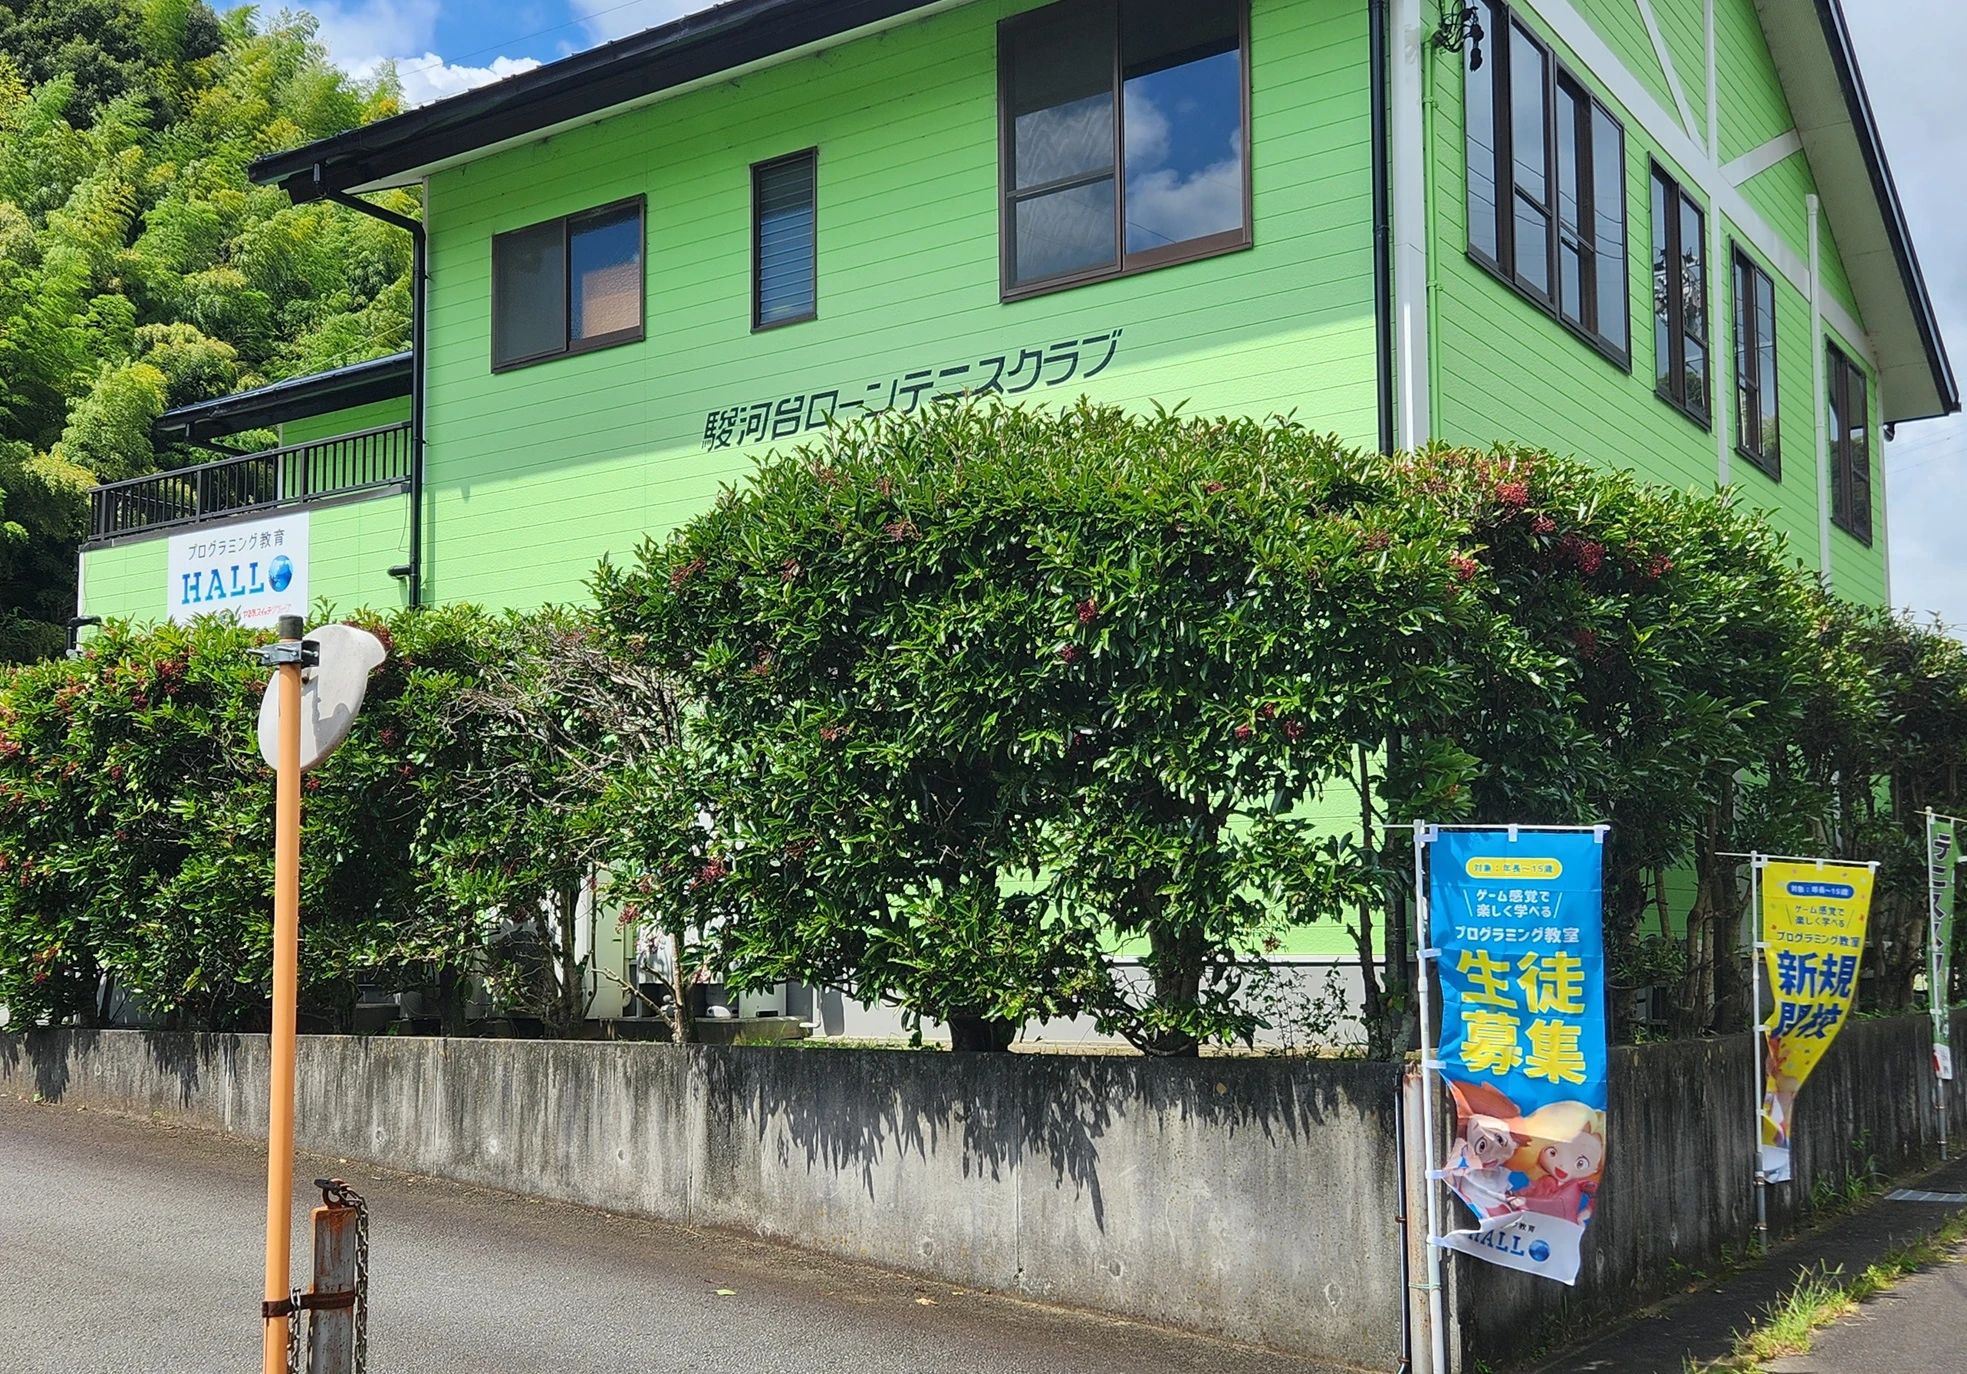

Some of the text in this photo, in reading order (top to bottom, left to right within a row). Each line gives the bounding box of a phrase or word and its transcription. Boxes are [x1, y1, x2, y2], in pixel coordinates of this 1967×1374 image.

[701, 328, 1123, 453] 駿河台ローンテニスクラブ
[188, 529, 285, 560] プログラミング教育
[1476, 888, 1550, 904] ゲーム感覚で
[1476, 904, 1552, 919] 楽しく学べる
[1794, 905, 1845, 917] ゲーム感覚で
[1794, 916, 1846, 928] 楽しく学べる
[1455, 926, 1581, 944] プログラミング教室
[1776, 931, 1861, 948] プログラミング教室
[1456, 949, 1586, 1014] 生徒
[1777, 950, 1858, 999] 新規
[1460, 1009, 1587, 1086] 募集
